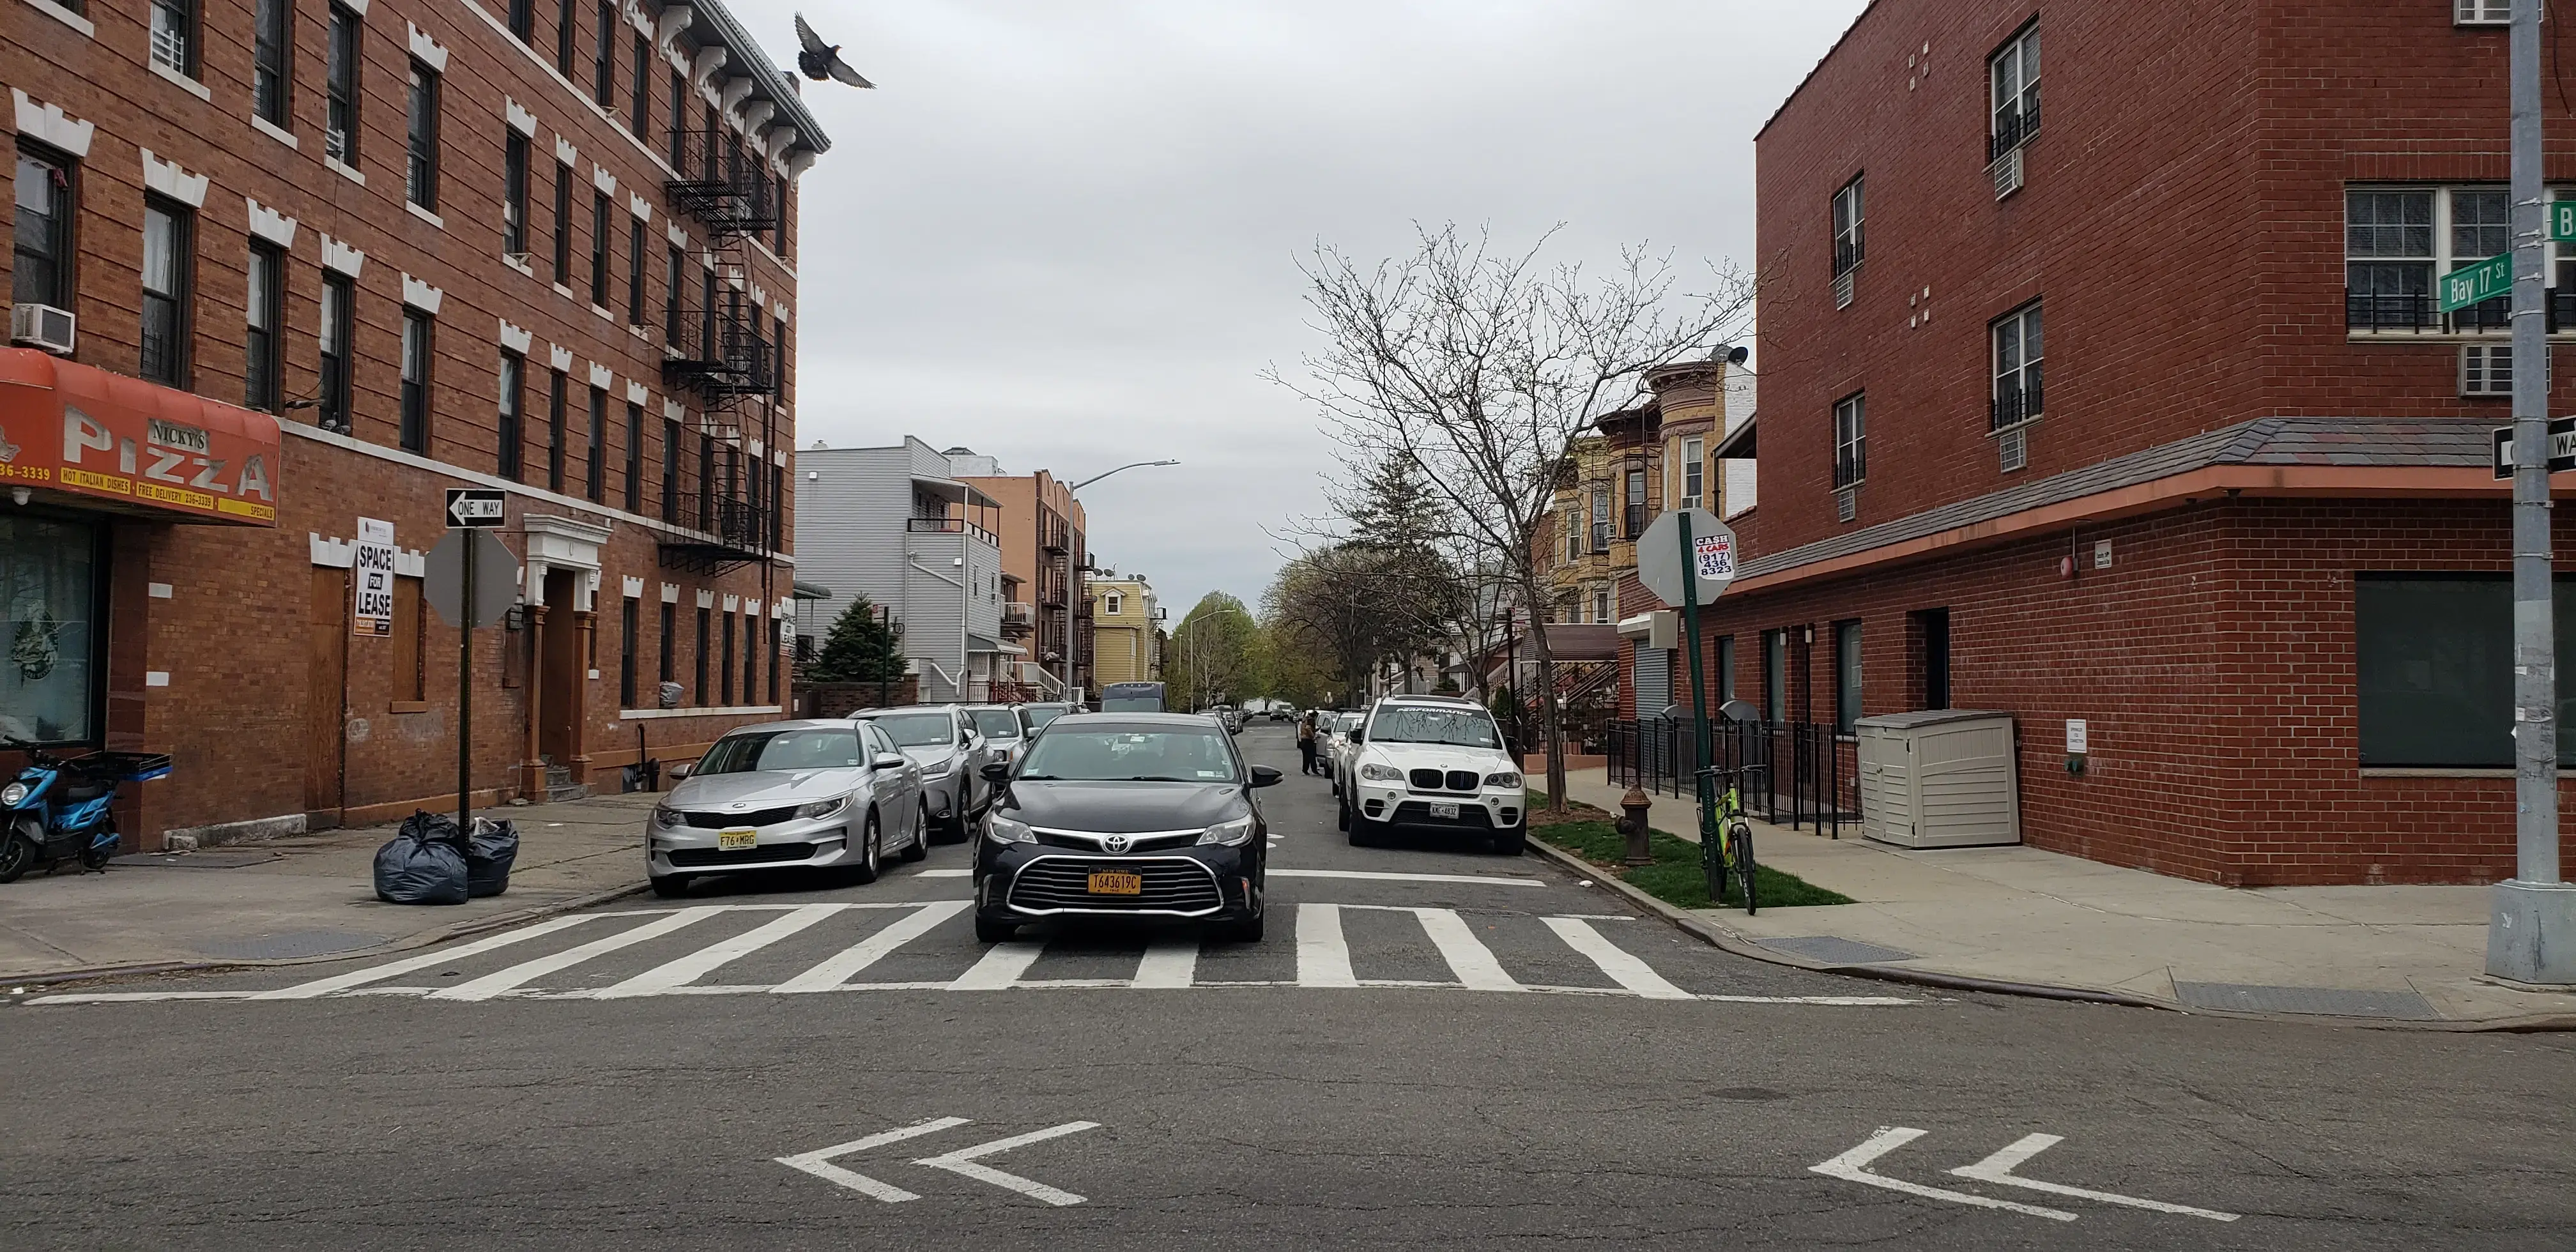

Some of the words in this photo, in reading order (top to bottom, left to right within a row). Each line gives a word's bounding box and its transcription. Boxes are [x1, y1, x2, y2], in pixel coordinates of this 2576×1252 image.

[2561, 207, 2576, 236] B
[2451, 278, 2473, 305] Bay
[2479, 266, 2491, 294] 17
[2496, 263, 2504, 279] St
[153, 424, 204, 449] NICKY'S
[63, 404, 273, 502] PIZZA
[63, 469, 76, 482] HOT
[80, 473, 103, 487] ITALIAN
[107, 478, 128, 492] DISHES
[138, 484, 153, 497] FREE
[156, 488, 182, 503] DELIVERY
[185, 493, 211, 507] 236-3339
[250, 505, 273, 519] SPECIALS
[458, 501, 475, 515] ONE
[482, 501, 500, 515] WAY
[1706, 544, 1729, 552] CARS
[359, 545, 392, 571] SPACE
[1699, 551, 1730, 564] (917)
[1704, 559, 1727, 568] 436
[1701, 565, 1732, 576] 8323
[369, 576, 381, 588] FOR
[358, 592, 391, 616] LEASE
[1396, 707, 1473, 716] PERFORMANCE
[1094, 874, 1137, 889] T643619C
